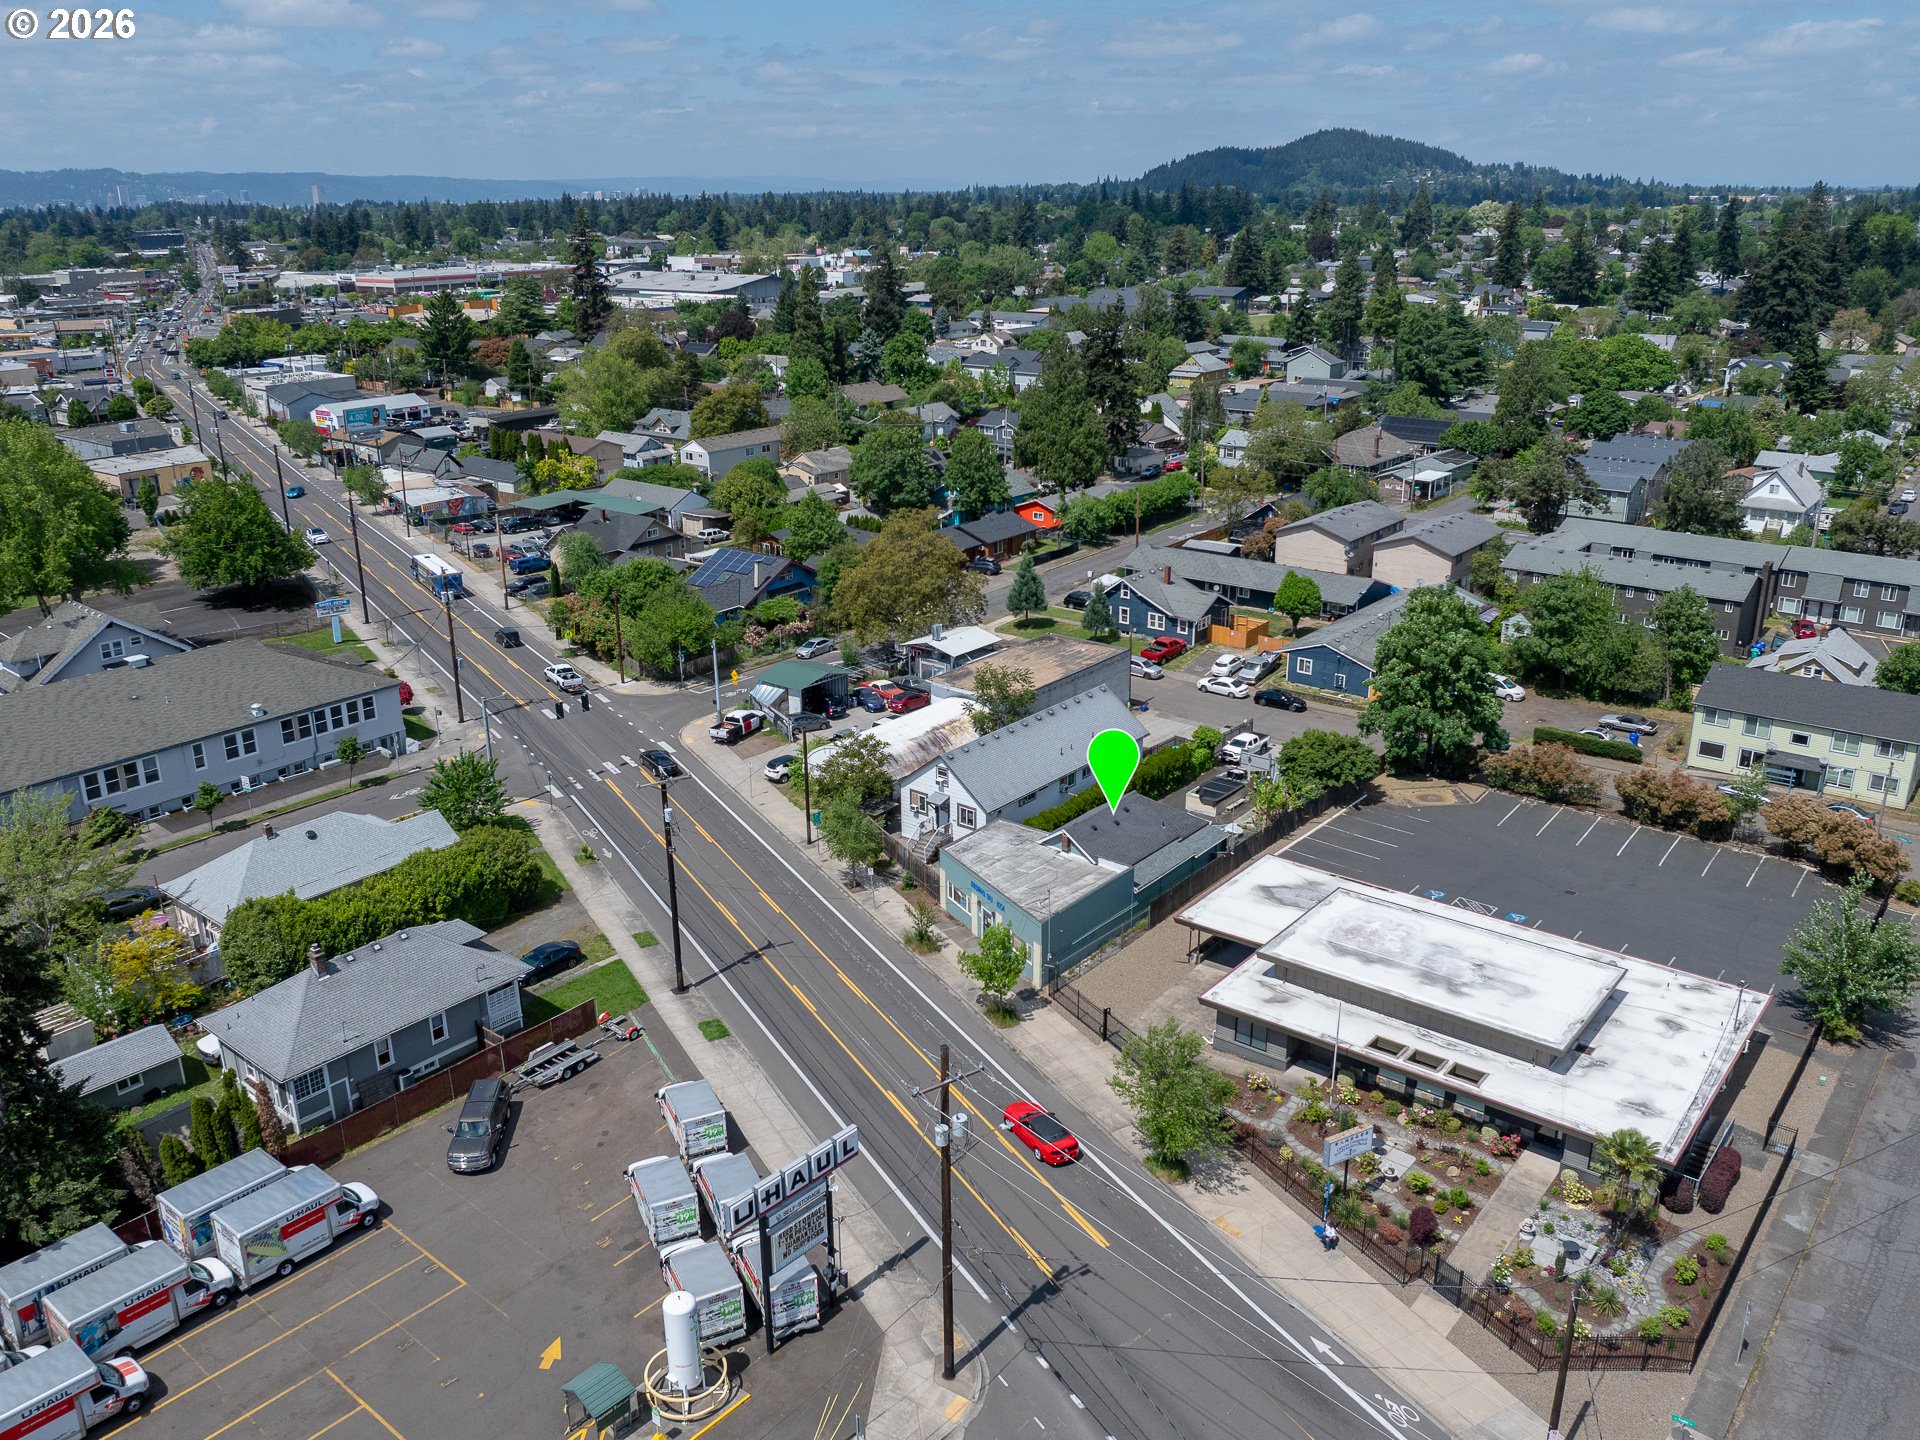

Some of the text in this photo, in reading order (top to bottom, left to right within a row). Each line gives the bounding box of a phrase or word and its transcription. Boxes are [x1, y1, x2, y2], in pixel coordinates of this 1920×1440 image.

[782, 1188, 821, 1218] SELF-STORAGE
[777, 1225, 794, 1241] NEED
[782, 1227, 825, 1259] NO SURPRISES
[785, 1221, 822, 1251] GUARANTEED
